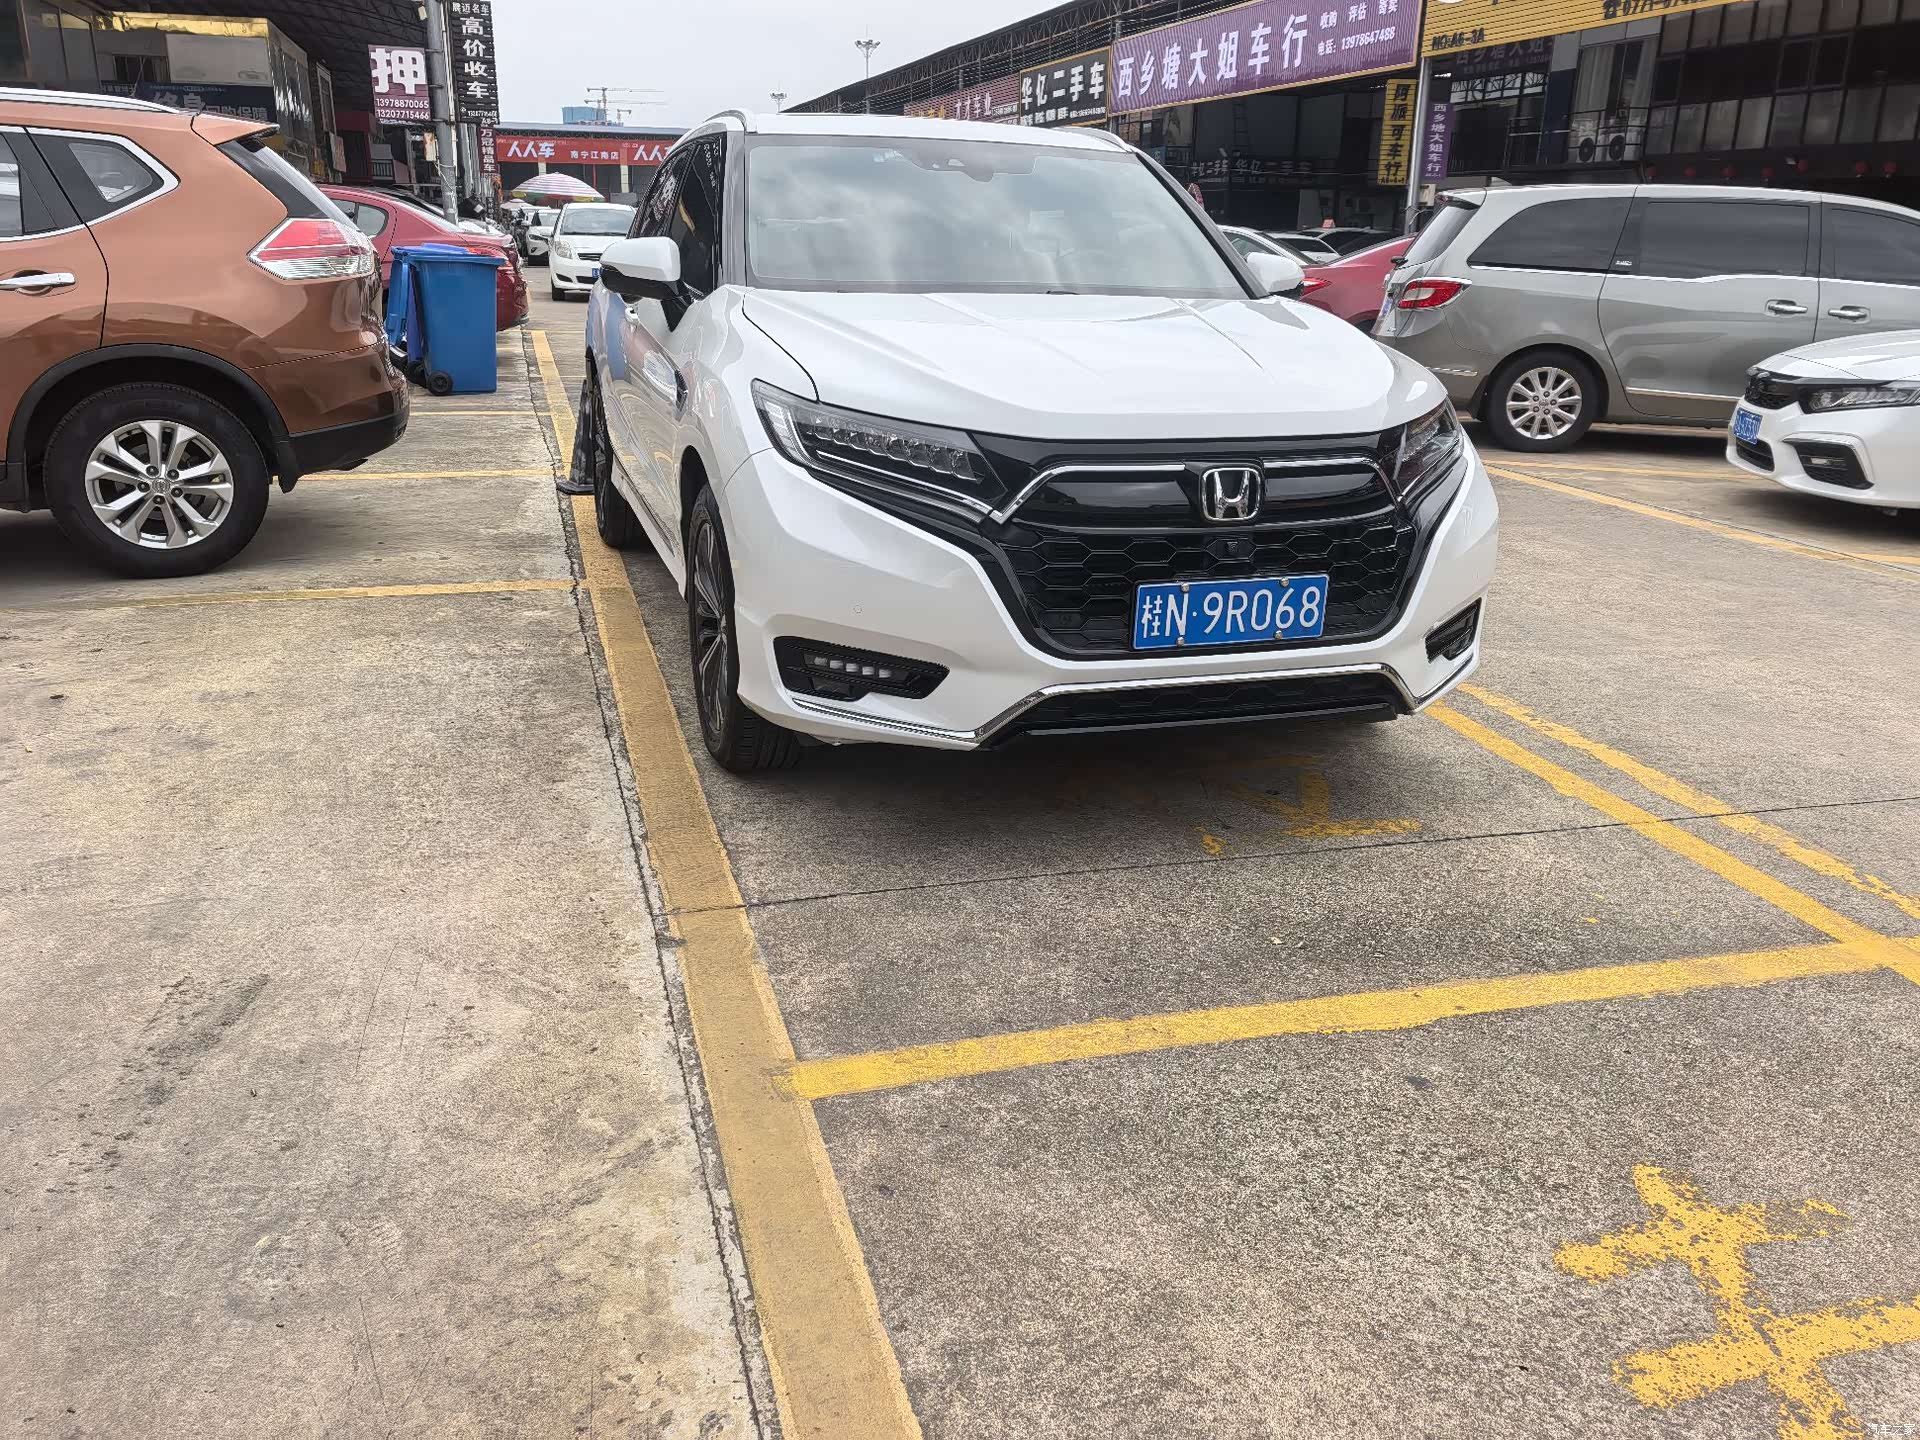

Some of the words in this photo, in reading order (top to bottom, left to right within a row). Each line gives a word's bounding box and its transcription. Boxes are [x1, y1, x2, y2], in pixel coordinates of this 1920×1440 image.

[370, 48, 427, 95] 押
[460, 16, 488, 98] 高价收车
[1117, 14, 1308, 99] 西乡塘大姐车行
[376, 98, 429, 109] 13978870065
[1022, 61, 1106, 111] 华亿二手车
[377, 109, 430, 120] 13207715466
[1426, 103, 1448, 172] 西乡塘大姐车行
[507, 141, 555, 158] 人人车
[1141, 587, 1321, 638] 桂N·9R068
